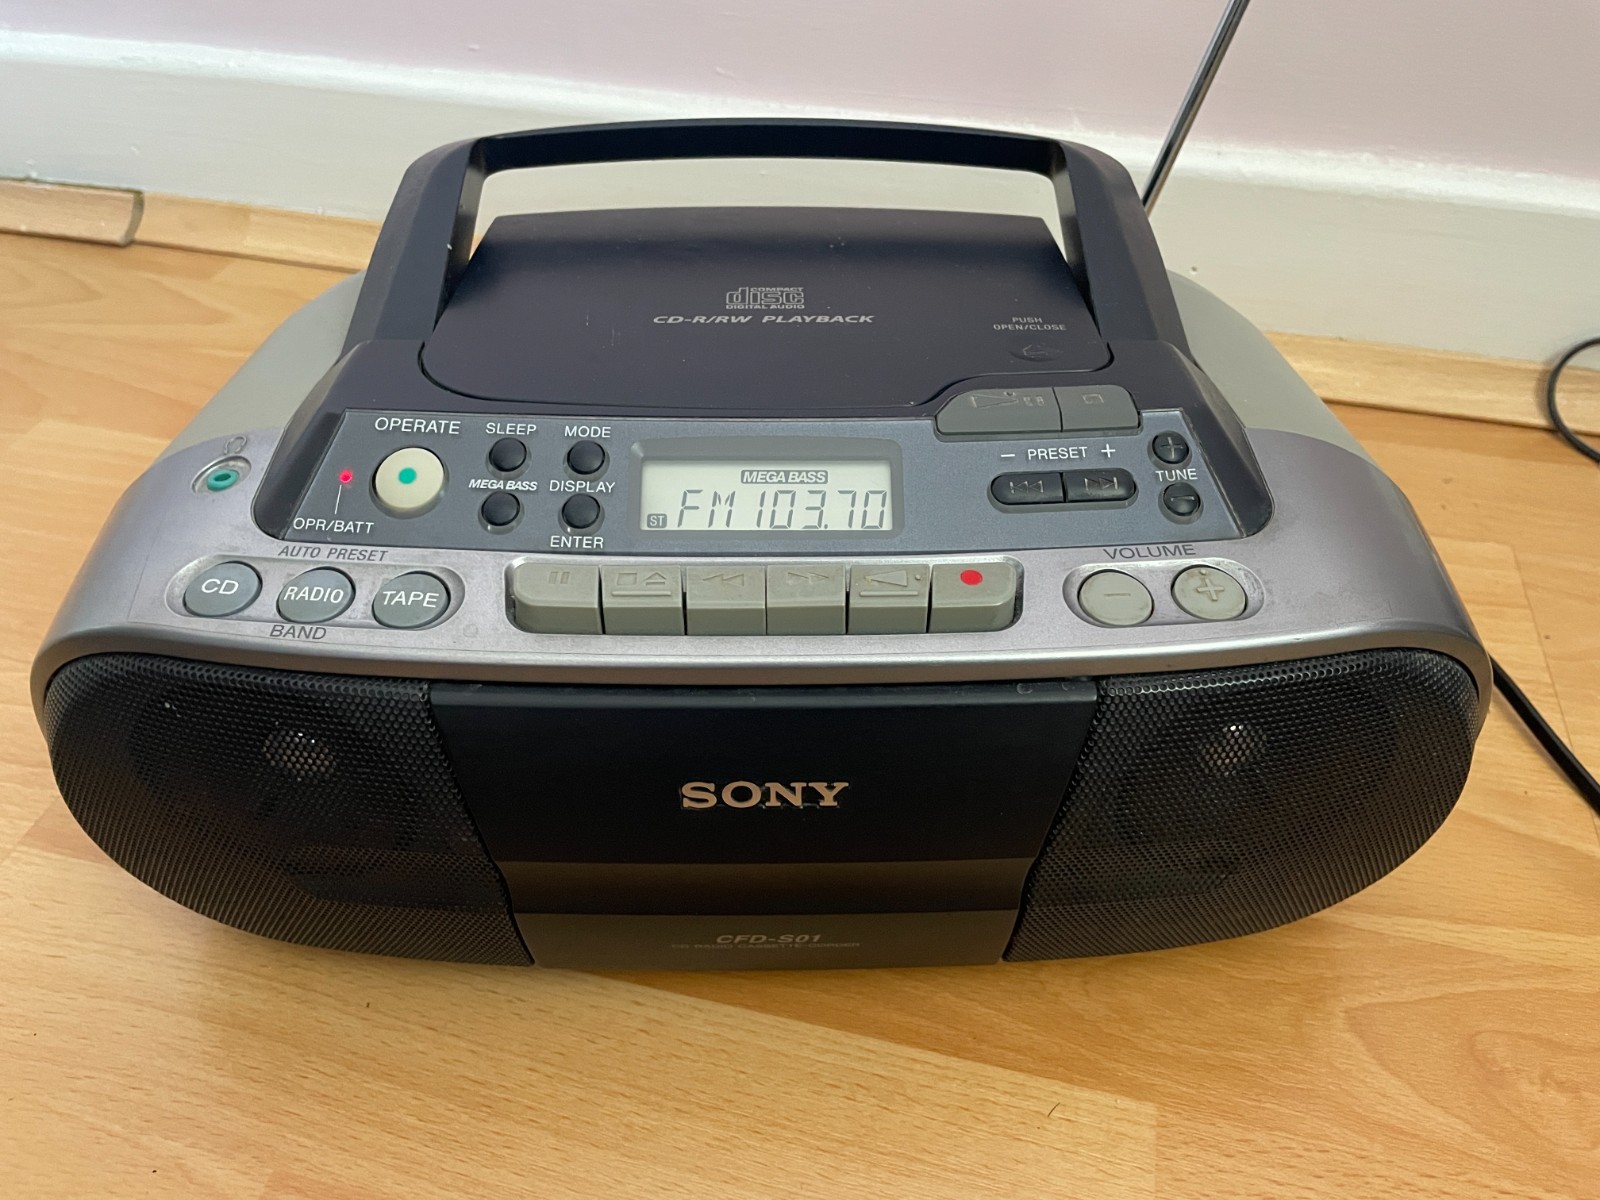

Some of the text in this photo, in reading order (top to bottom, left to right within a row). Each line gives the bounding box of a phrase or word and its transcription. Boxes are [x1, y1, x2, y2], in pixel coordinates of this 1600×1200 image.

[725, 286, 805, 305] disc
[653, 315, 876, 324] CD-R/RW PLAYBACK
[993, 323, 1067, 331] OPEN/CLOSE
[374, 416, 461, 435] OPERATE
[485, 422, 537, 436] SLEEP
[564, 425, 612, 438] MODE
[1027, 446, 1088, 461] PRESET
[743, 471, 827, 483] MEGA BASS
[1155, 468, 1198, 482] TUNE
[468, 478, 538, 491] MEGA BASS
[549, 480, 616, 493] DISPLAY
[677, 489, 888, 530] FM 103.70
[293, 517, 375, 534] OPR/BATT
[649, 515, 666, 527] ST
[550, 535, 604, 549] ENTER
[278, 545, 389, 562] AUTO PRESET
[1103, 544, 1197, 560] VOLUME
[200, 578, 239, 595] CD
[283, 586, 344, 604] RADIO
[382, 590, 440, 608] TAPE
[269, 624, 327, 640] BAND
[680, 780, 850, 809] SONY
[716, 934, 822, 944] CFD-S01
